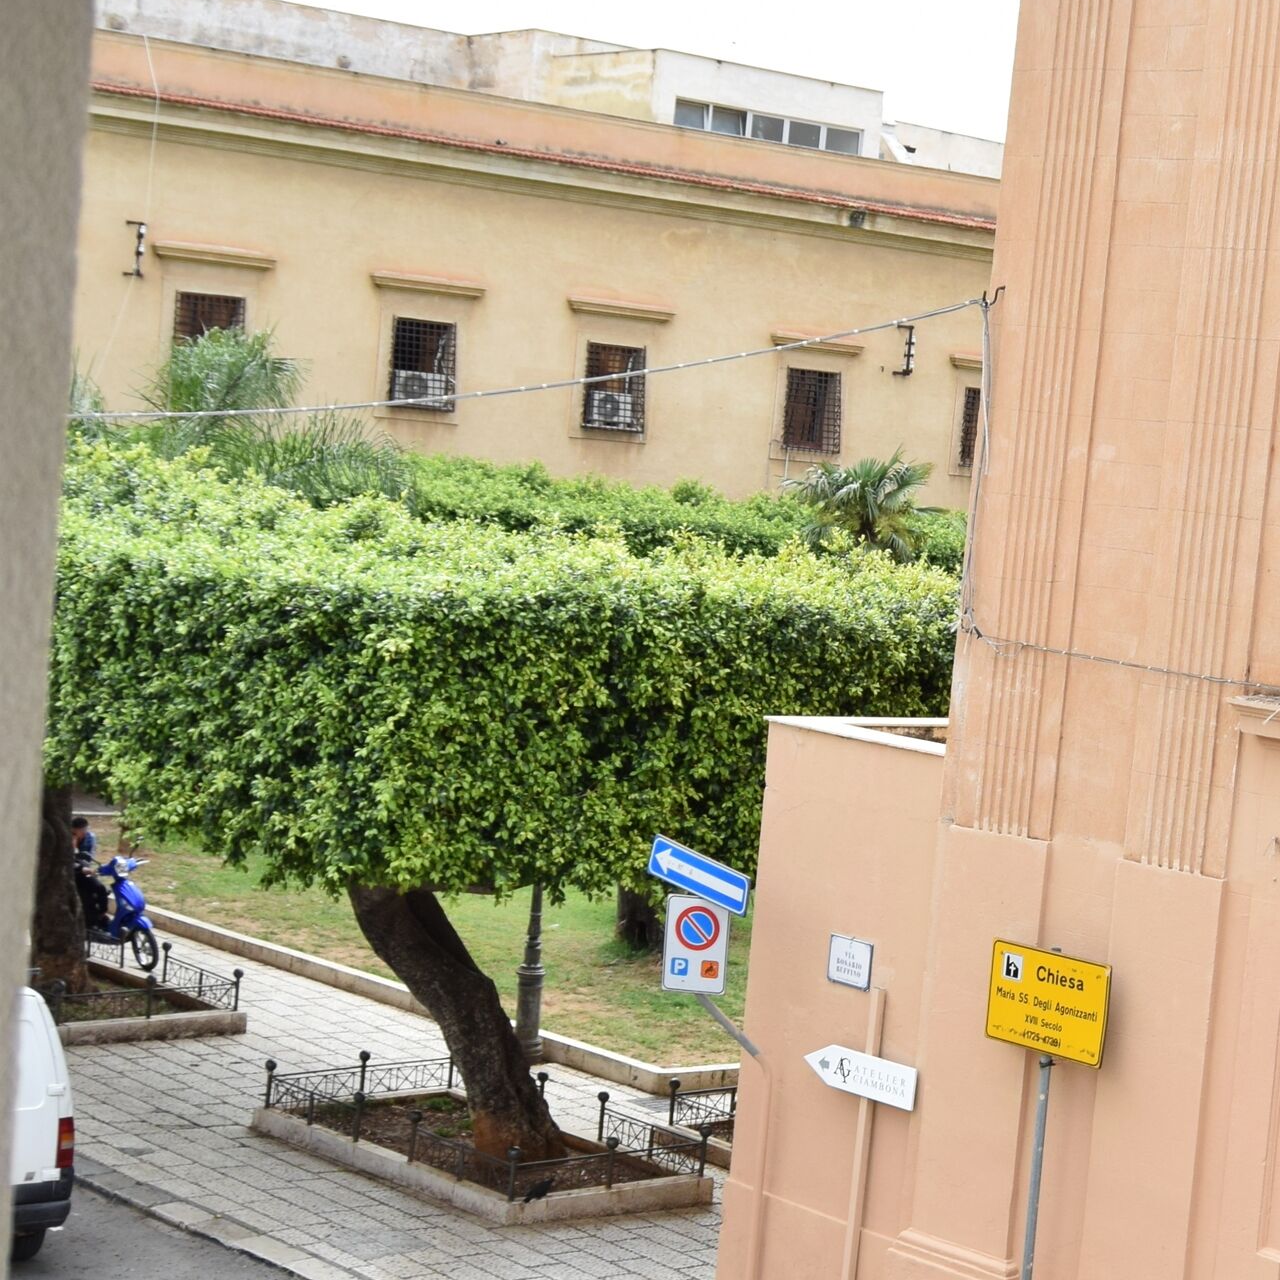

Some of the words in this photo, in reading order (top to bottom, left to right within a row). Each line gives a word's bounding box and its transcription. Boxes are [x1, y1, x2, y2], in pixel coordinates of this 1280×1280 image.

[674, 959, 687, 974] P
[1036, 965, 1084, 992] Chiesa
[996, 986, 1016, 1001] Maria
[1033, 996, 1053, 1012] Degli
[1055, 1002, 1098, 1023] Agonizzanti
[1040, 1018, 1063, 1033] Secolo
[854, 1064, 906, 1088] ATELIER
